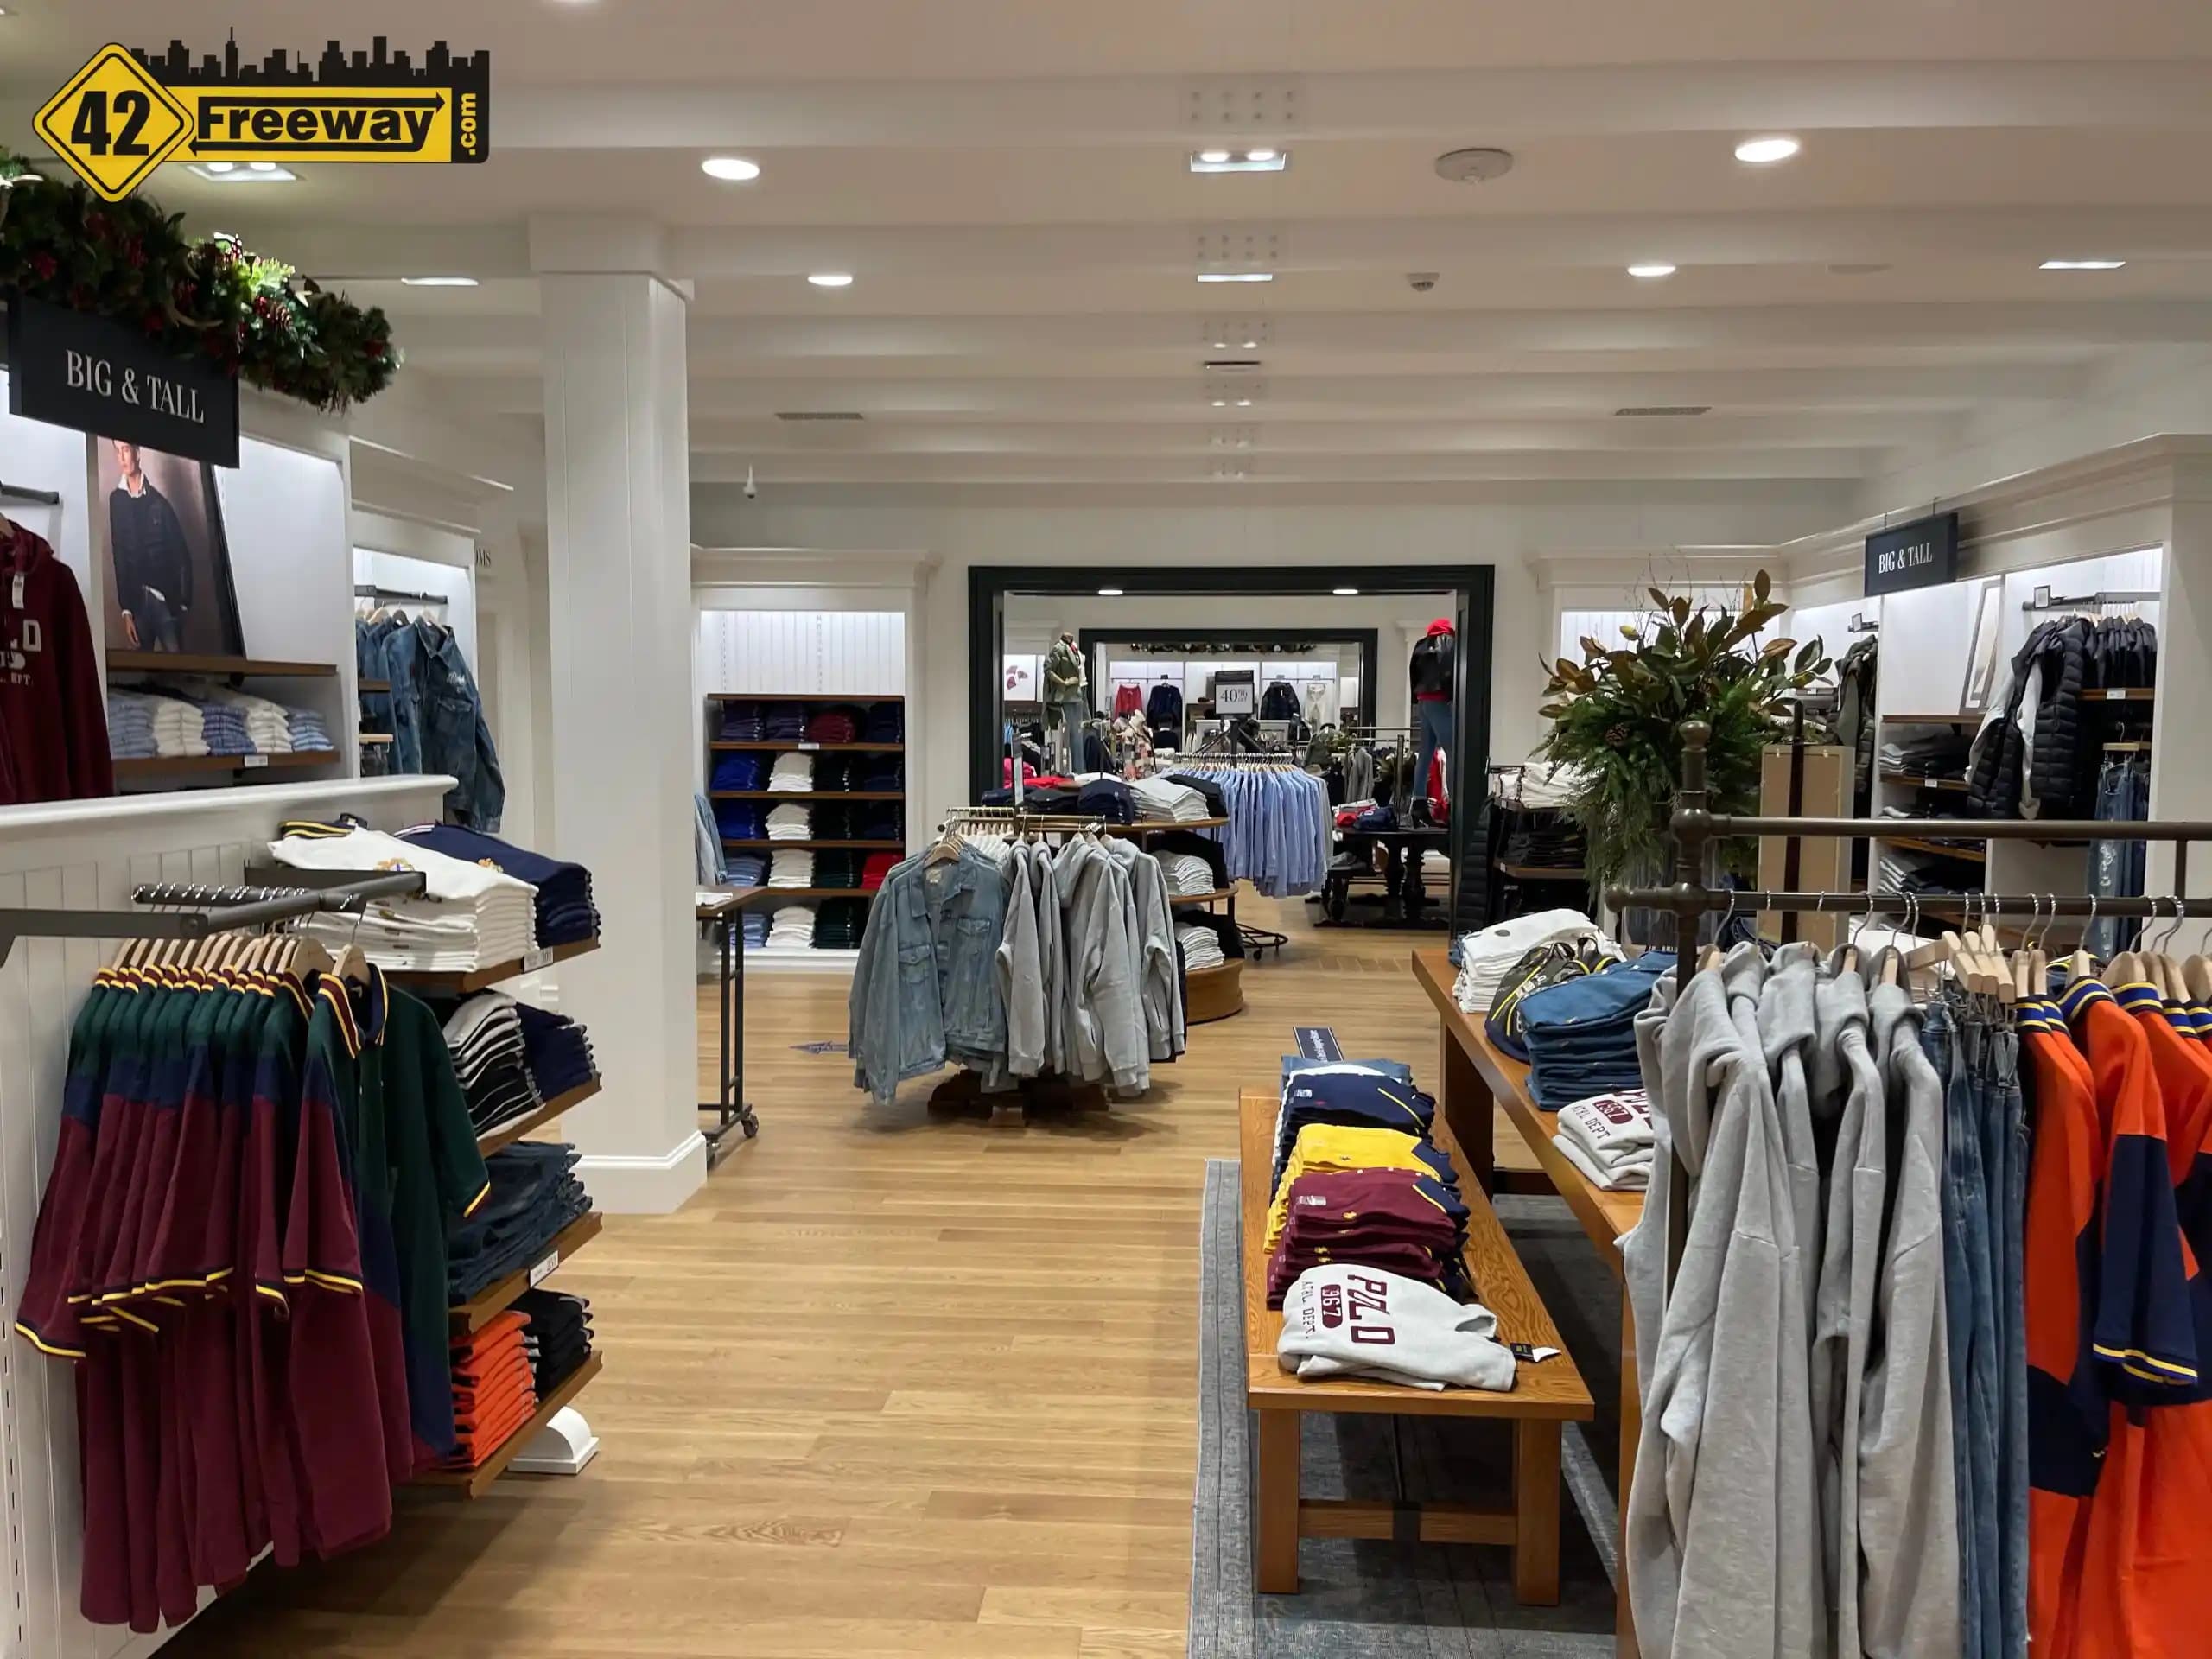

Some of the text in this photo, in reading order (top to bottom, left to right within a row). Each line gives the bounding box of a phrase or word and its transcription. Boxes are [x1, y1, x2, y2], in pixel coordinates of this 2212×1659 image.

[66, 349, 205, 423] BIG & TALL
[1878, 542, 1933, 574] BIG & TALL
[1347, 1274, 1395, 1344] POLO
